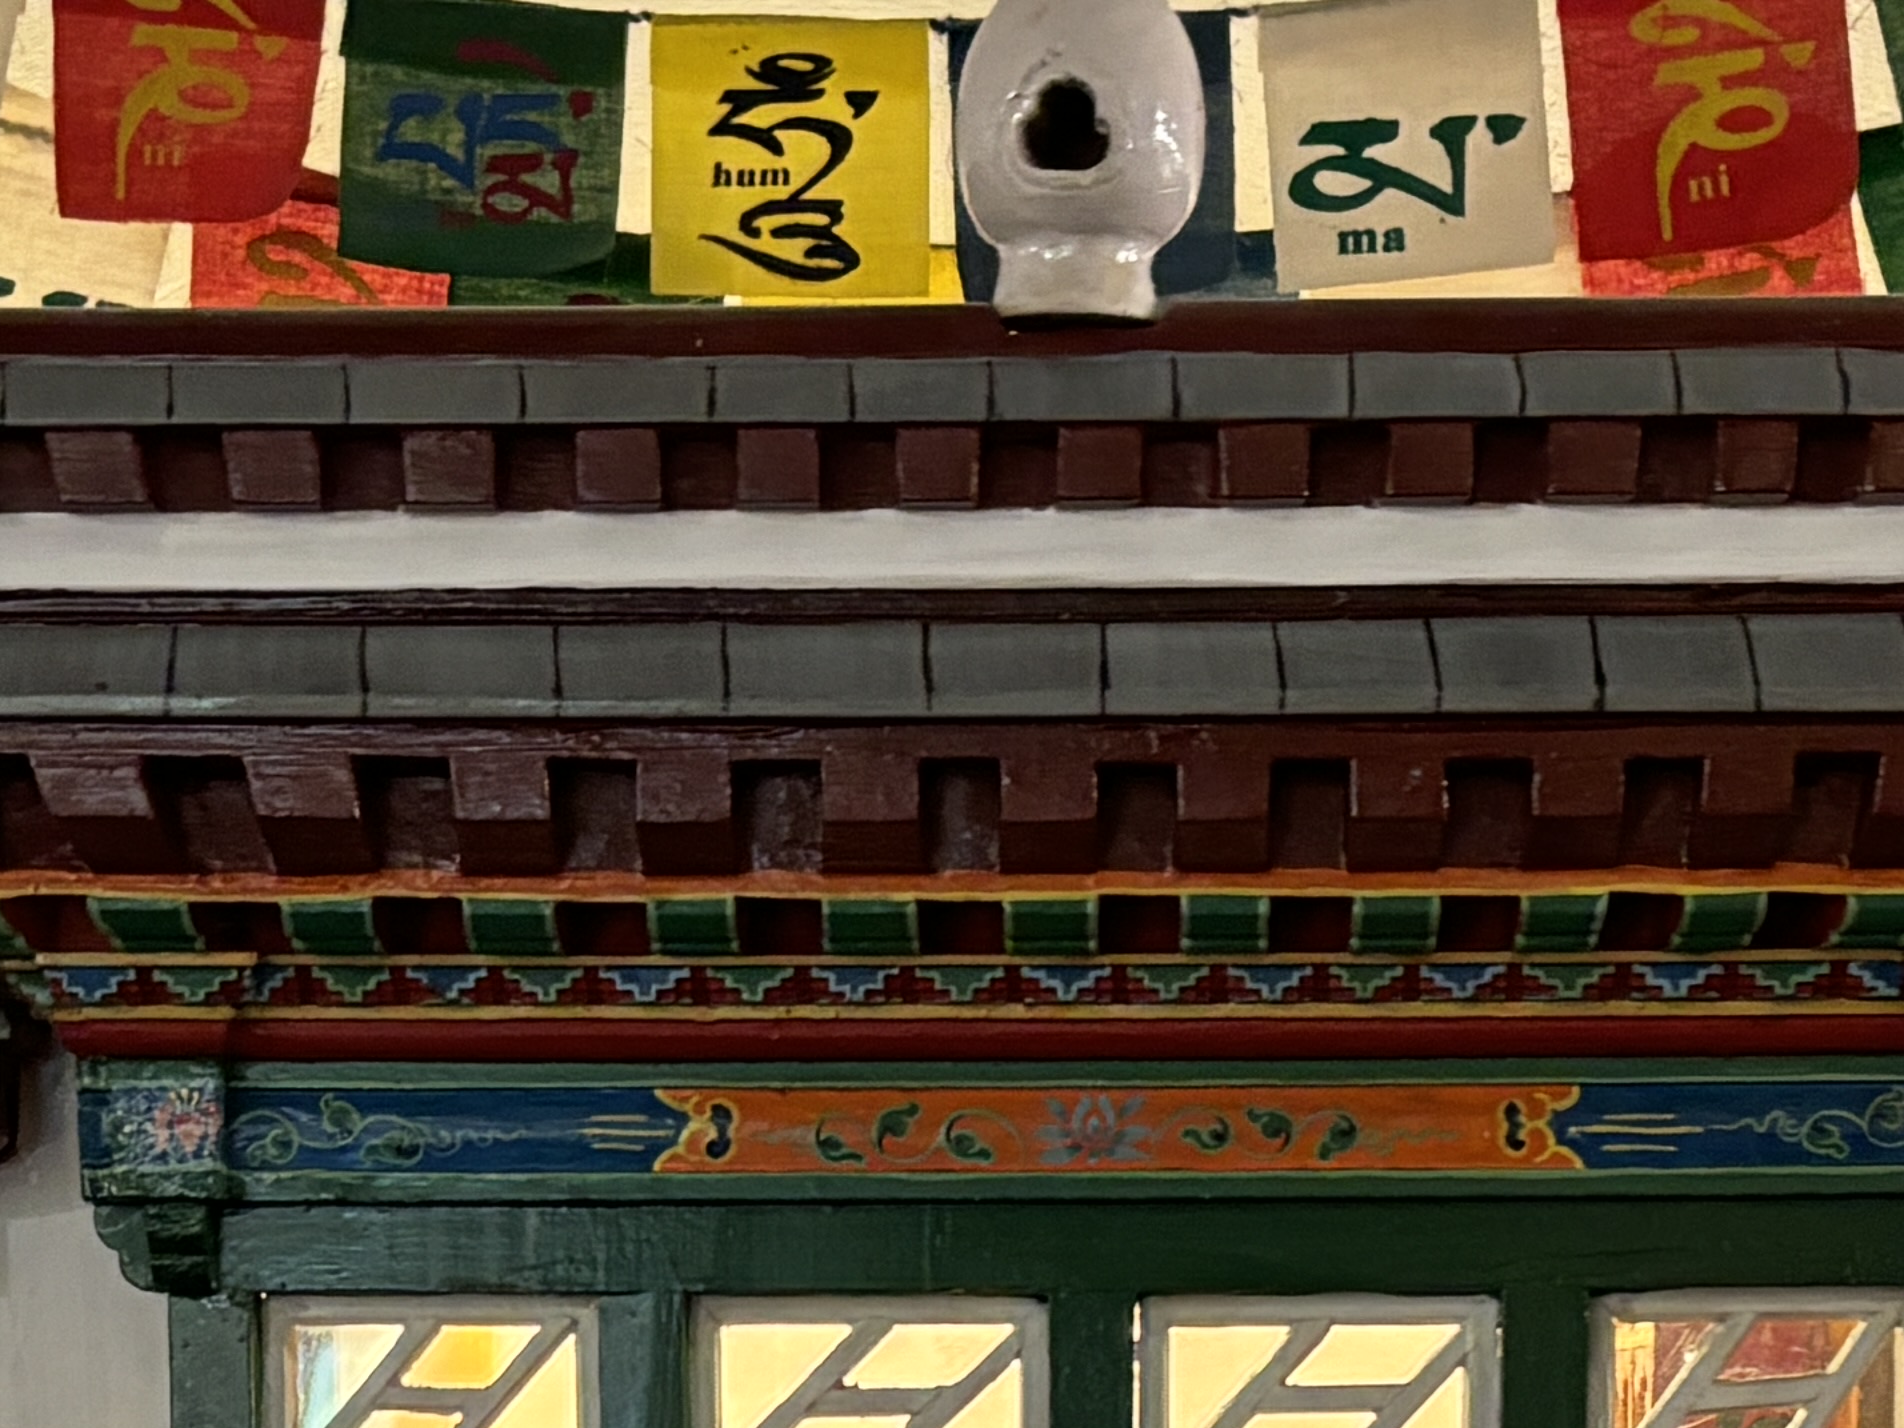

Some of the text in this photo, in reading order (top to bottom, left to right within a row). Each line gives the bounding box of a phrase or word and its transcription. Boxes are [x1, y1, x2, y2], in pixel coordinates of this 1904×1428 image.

[711, 161, 791, 188] hum
[1688, 163, 1731, 203] ni
[1337, 227, 1406, 255] ma
